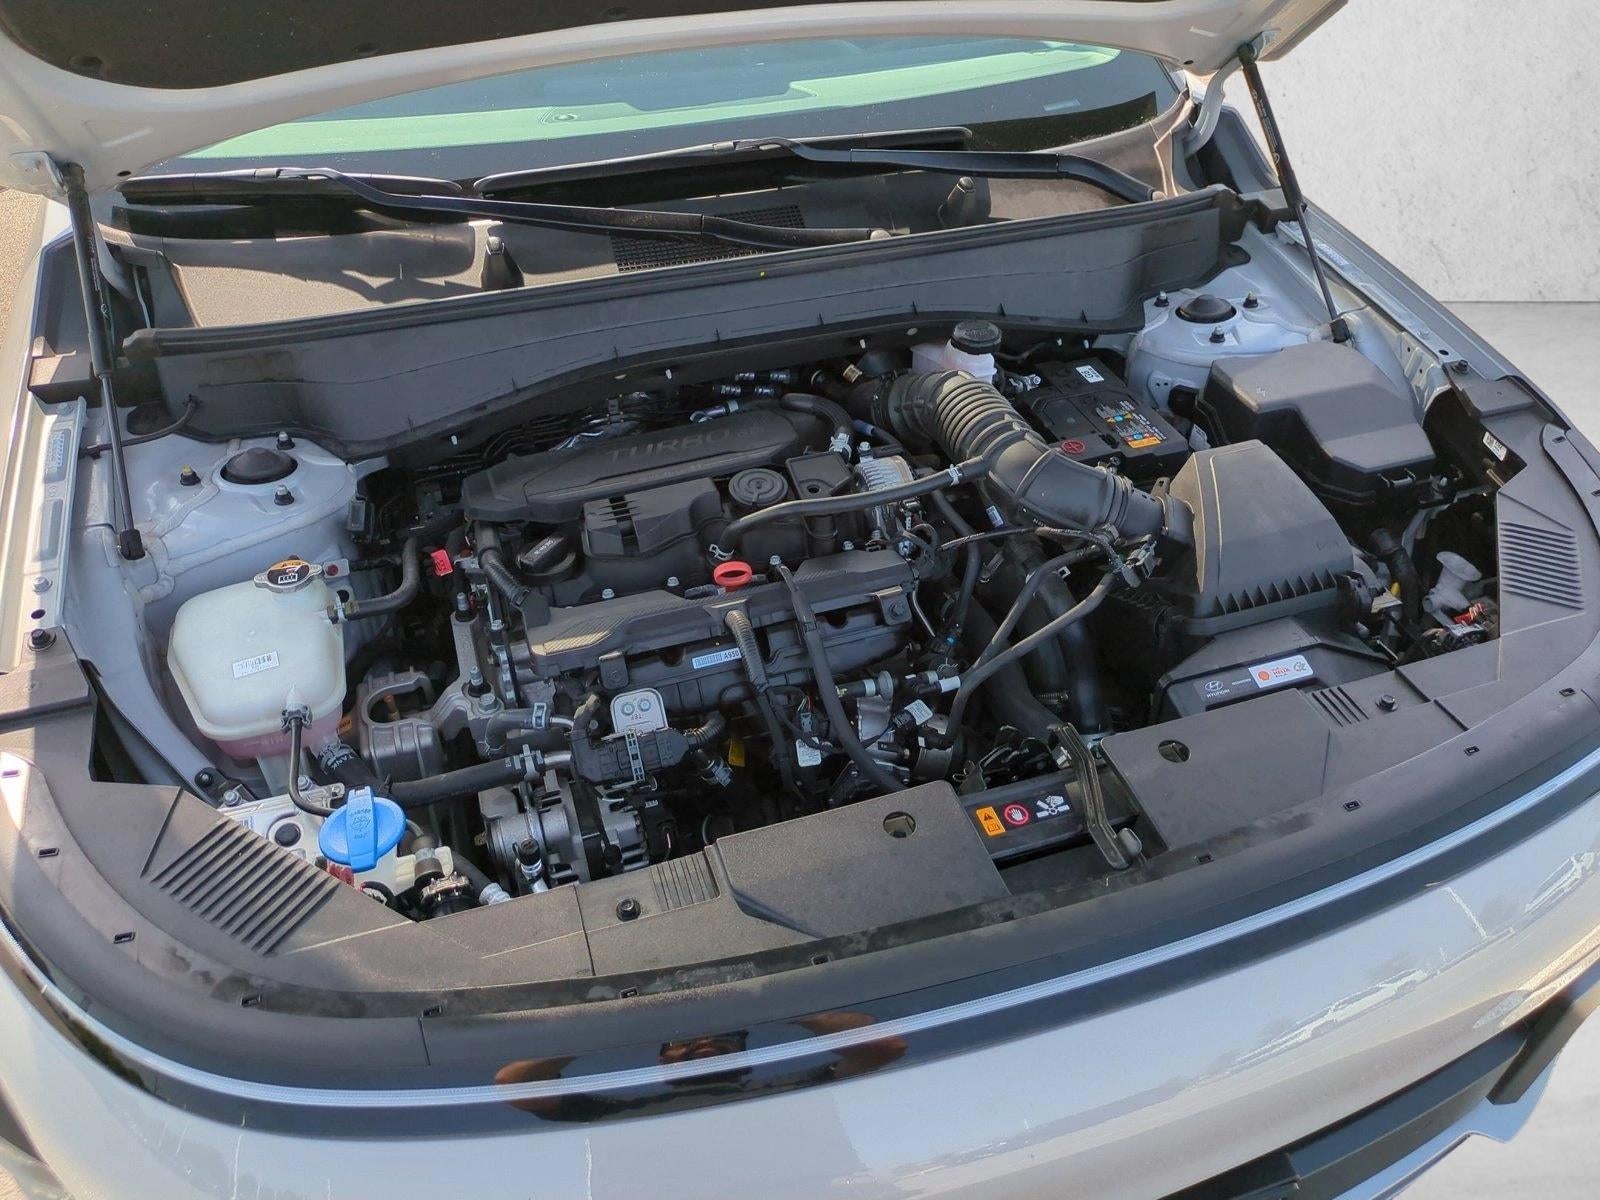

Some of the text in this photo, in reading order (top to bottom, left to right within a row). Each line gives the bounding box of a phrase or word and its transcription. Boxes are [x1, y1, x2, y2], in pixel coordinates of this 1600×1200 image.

[607, 427, 731, 461] TURBO
[724, 650, 739, 660] A950
[332, 753, 355, 771] TANK
